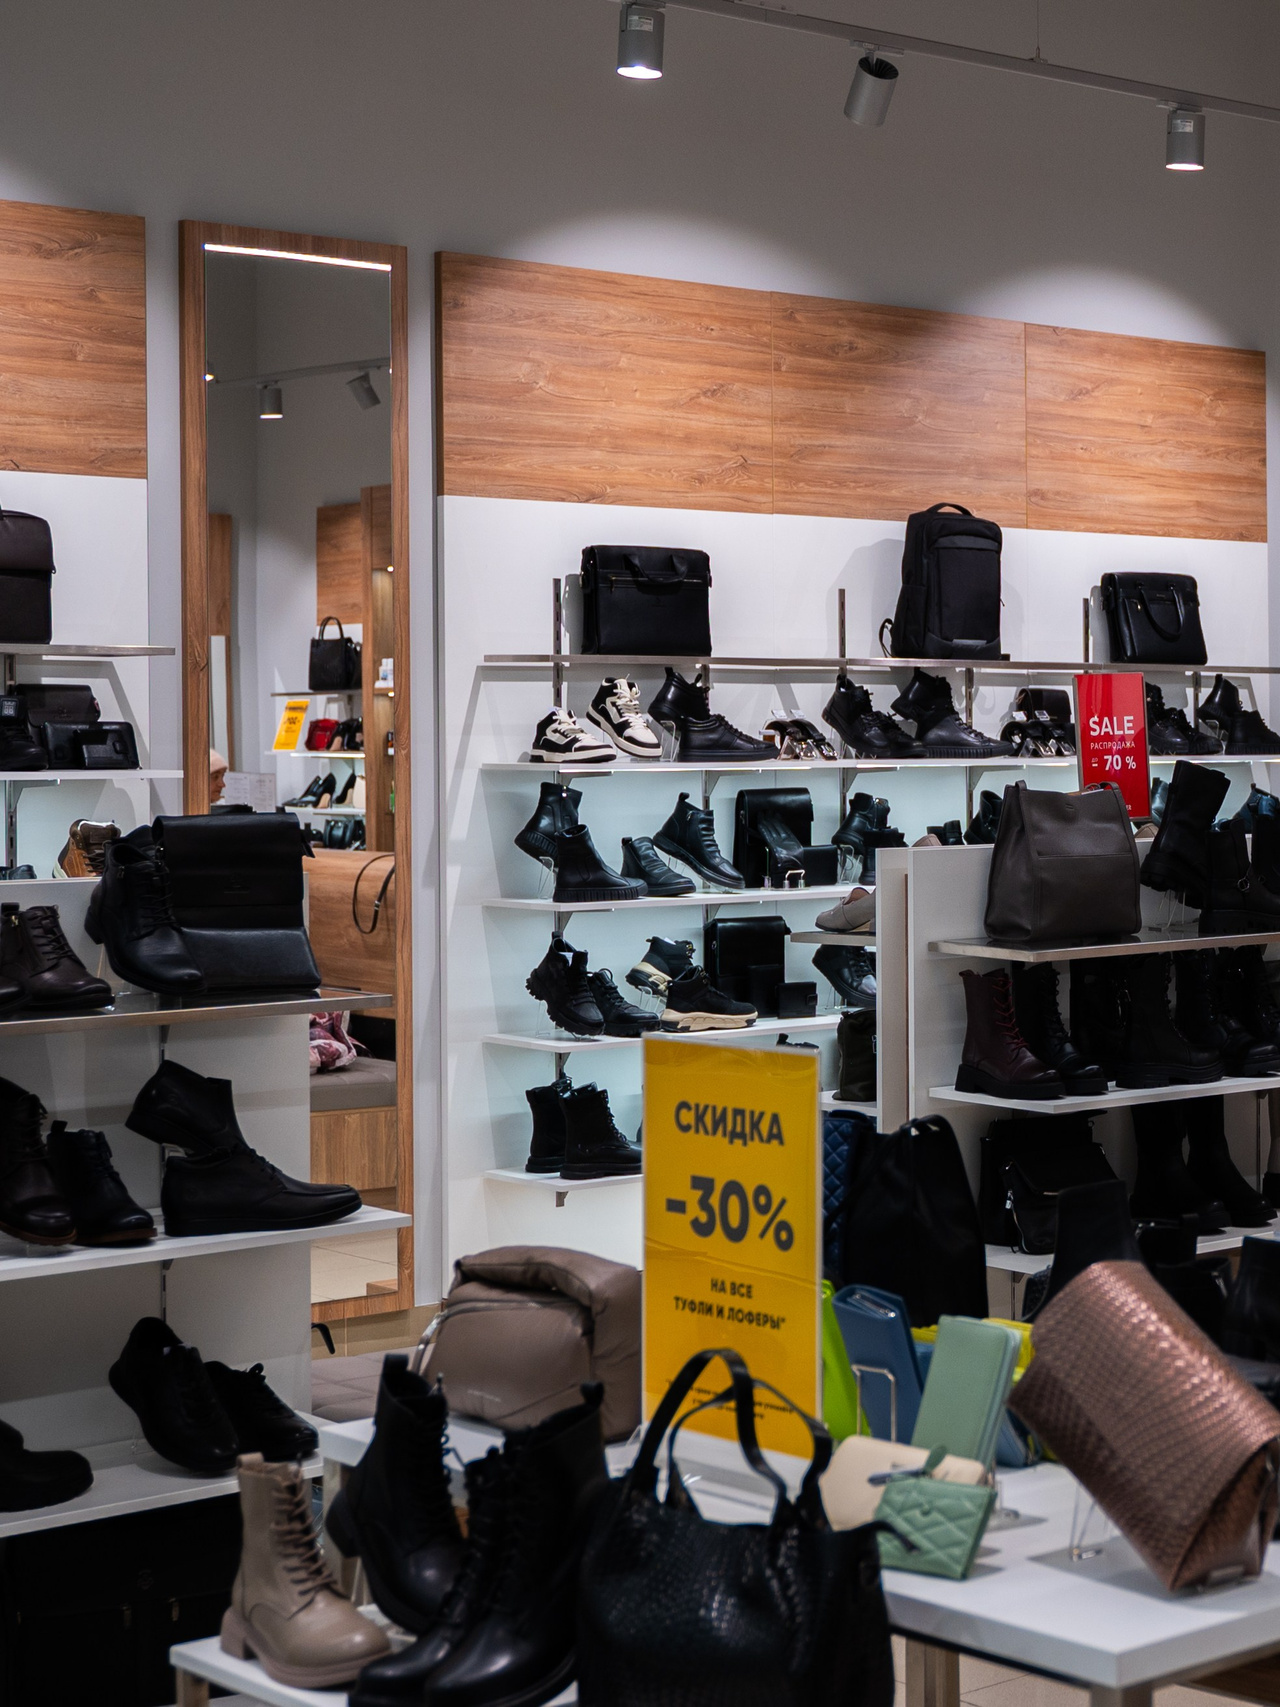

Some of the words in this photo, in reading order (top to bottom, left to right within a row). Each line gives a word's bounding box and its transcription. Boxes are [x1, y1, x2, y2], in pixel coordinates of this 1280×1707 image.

[1089, 716, 1134, 735] SALE
[1090, 741, 1136, 750] РАСПРОДАЖА
[674, 1100, 784, 1147] СКИДКА
[665, 1174, 794, 1252] -30%
[710, 1278, 727, 1295] НА
[729, 1281, 754, 1299] ВСЕ
[673, 1295, 714, 1317] ТУФЛИ
[716, 1303, 725, 1320] И
